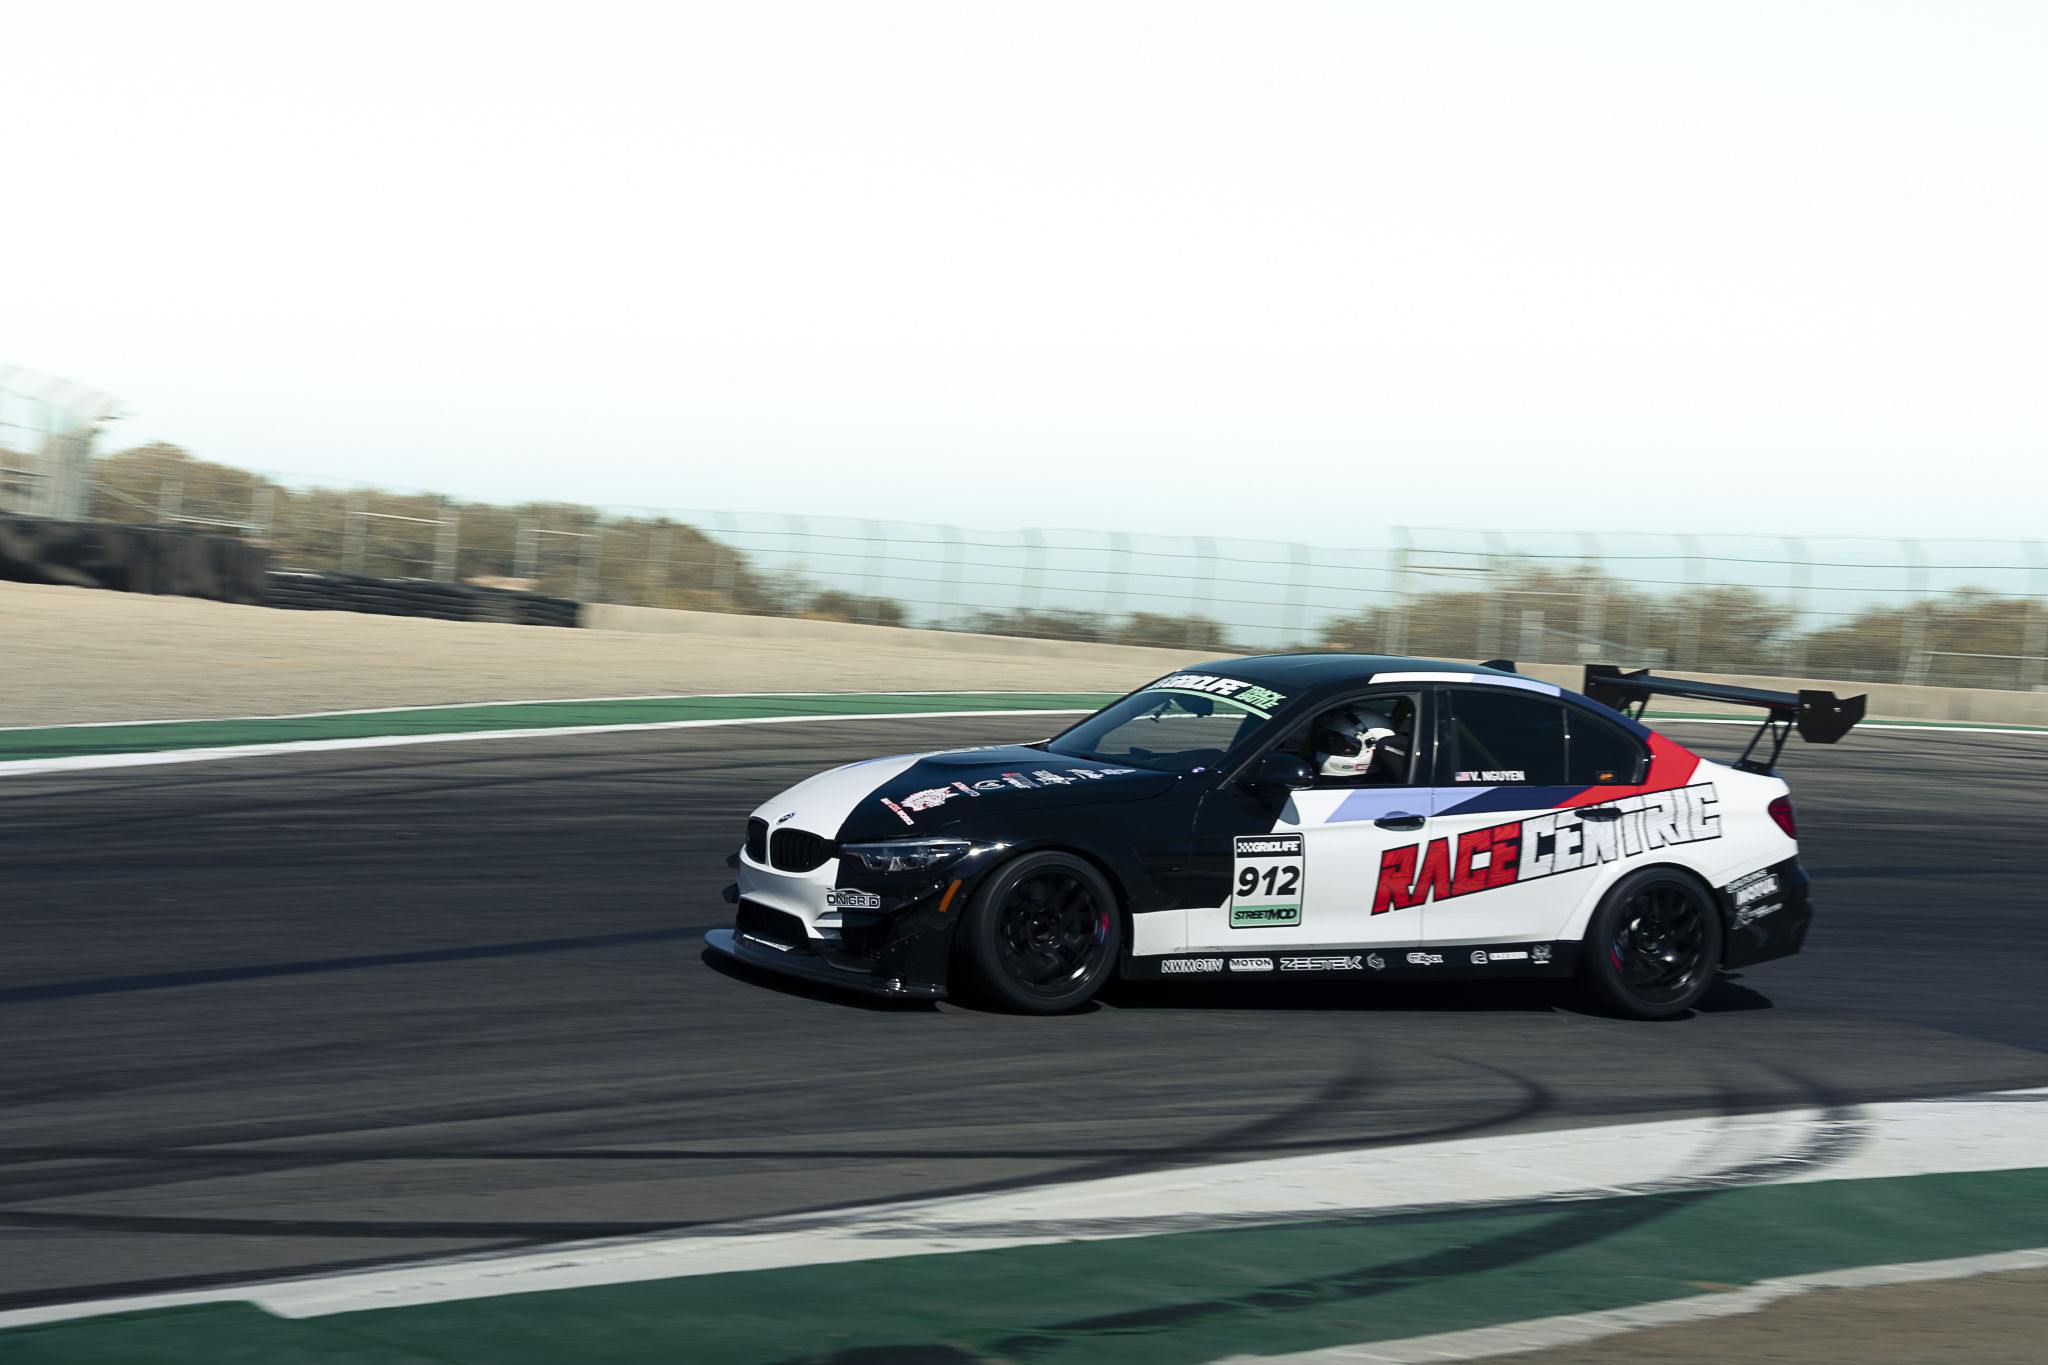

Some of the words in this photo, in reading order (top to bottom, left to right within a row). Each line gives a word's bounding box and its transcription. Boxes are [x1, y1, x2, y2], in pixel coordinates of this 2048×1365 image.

[1469, 771, 1481, 781] V.
[1482, 771, 1525, 781] NGUYEN
[1252, 840, 1300, 852] GRIDLIFE
[1236, 865, 1300, 897] 912
[1231, 958, 1272, 967] MOTON
